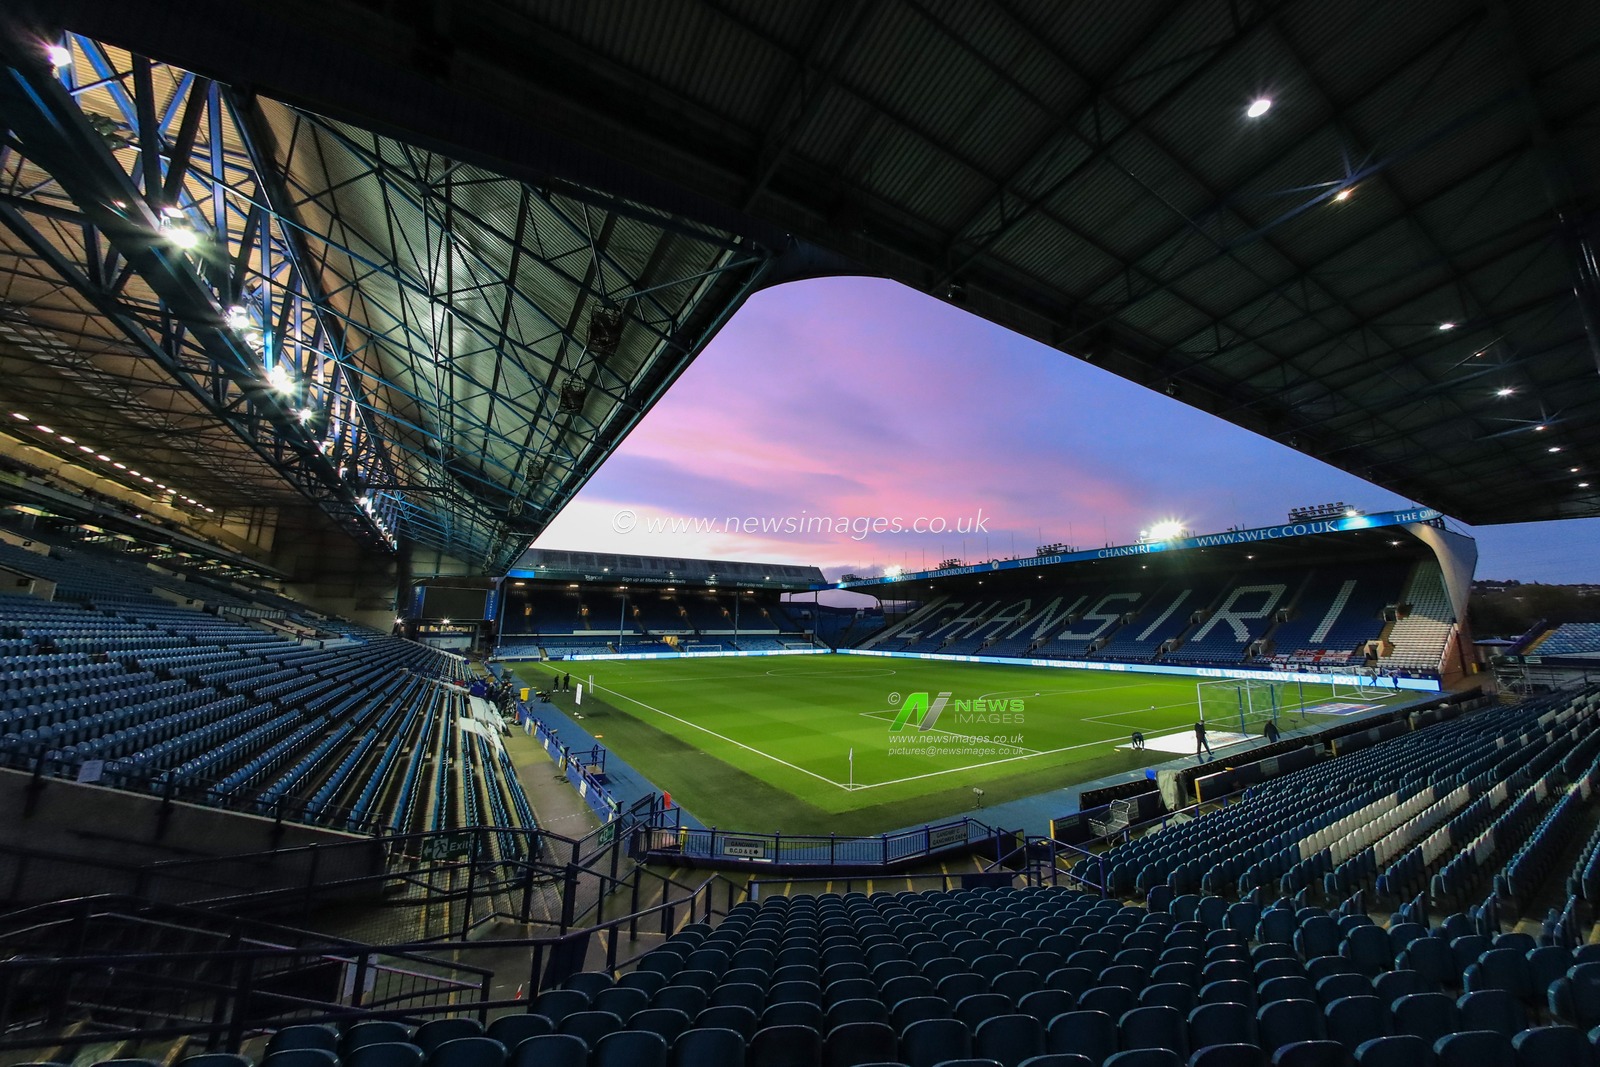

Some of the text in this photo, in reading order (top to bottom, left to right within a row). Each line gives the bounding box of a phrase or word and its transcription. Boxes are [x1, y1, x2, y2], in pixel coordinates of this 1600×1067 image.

[1393, 511, 1418, 522] THE
[1196, 520, 1339, 547] WWW.SWFC.CO.UK
[1097, 543, 1151, 559] CHANSIRI
[1018, 555, 1062, 568] SHEFFIELD
[927, 566, 975, 578] HILLSBOROUGH
[898, 580, 1358, 643] CHANSIRI
[1196, 667, 1222, 678] CLUB
[1224, 669, 1289, 682] WEDNESDAY
